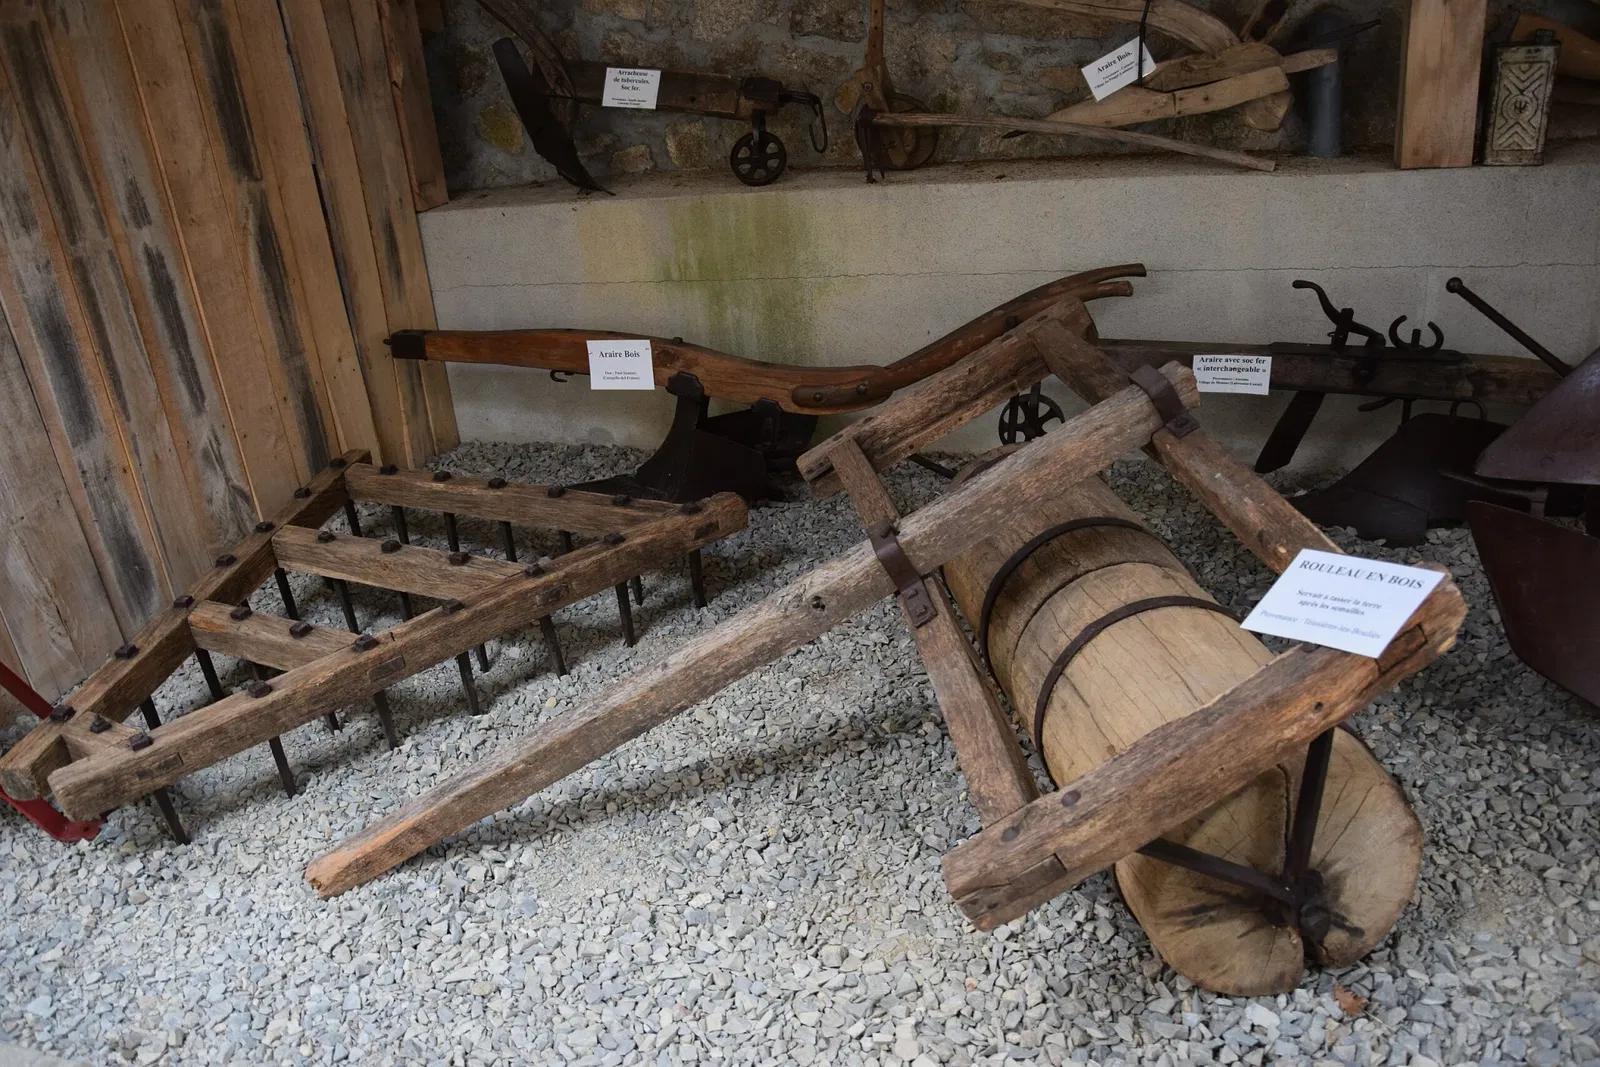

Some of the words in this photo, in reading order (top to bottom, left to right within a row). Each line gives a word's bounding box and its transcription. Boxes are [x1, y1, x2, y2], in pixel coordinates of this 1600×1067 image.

[1097, 59, 1117, 73] Araire
[1116, 52, 1132, 62] Bois.
[1300, 560, 1366, 577] ROULEAU
[1366, 572, 1387, 582] EN
[1388, 575, 1425, 590] BOIS
[1297, 590, 1322, 599] Servait
[1362, 601, 1381, 609] terre
[1331, 606, 1364, 615] semailles
